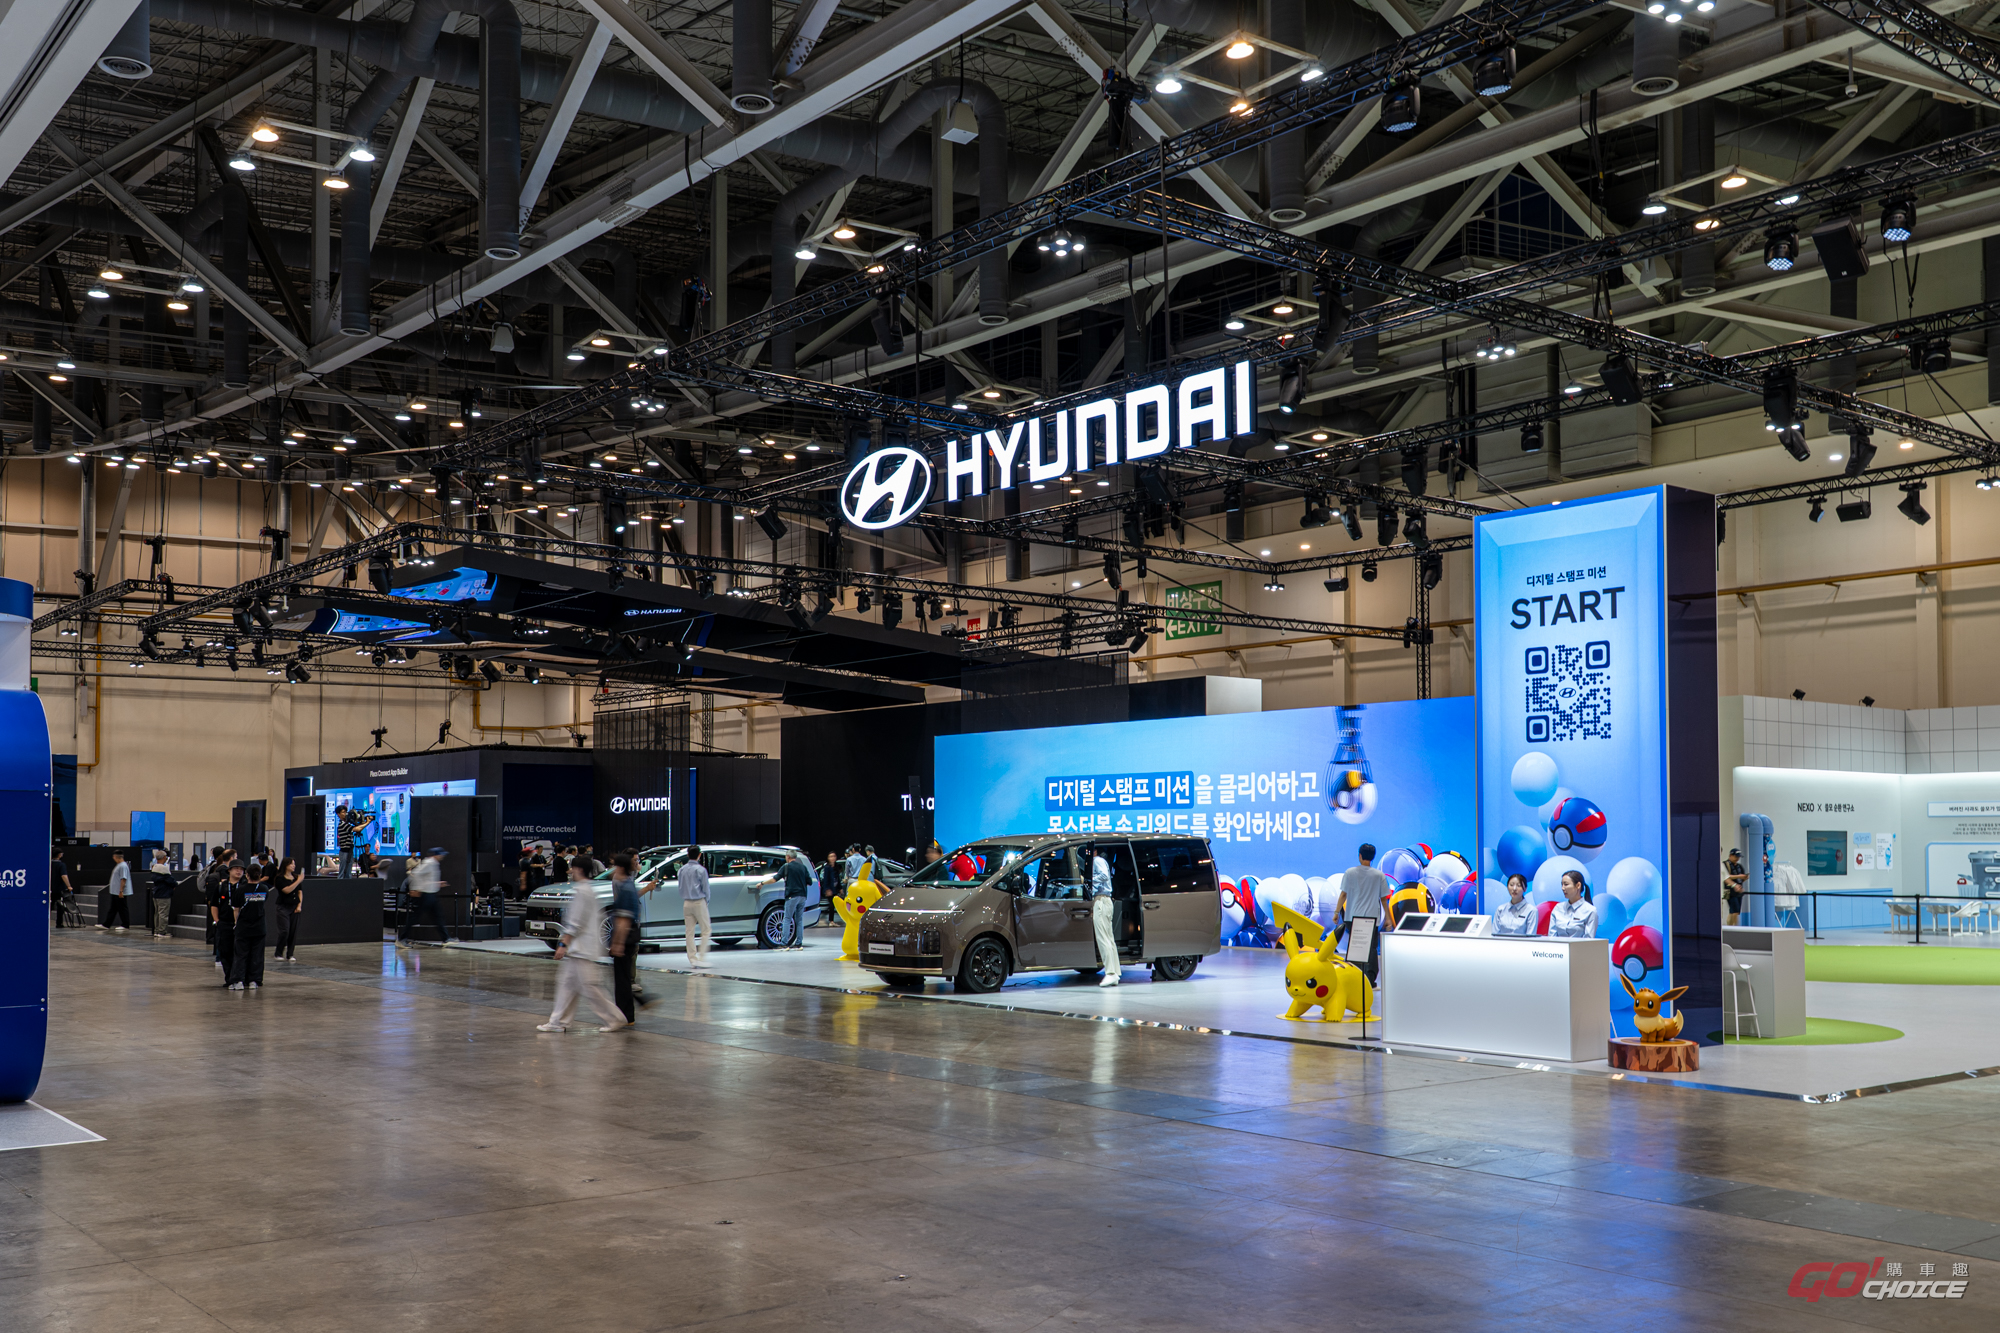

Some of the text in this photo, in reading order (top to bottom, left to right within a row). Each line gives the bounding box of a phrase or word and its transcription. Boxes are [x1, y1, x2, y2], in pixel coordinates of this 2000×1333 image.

[947, 360, 1252, 501] HYUNDAI
[1526, 565, 1607, 587] 디지털 스탬프 미션
[1510, 586, 1625, 630] START
[1049, 778, 1095, 807] 디지털
[1099, 777, 1151, 806] 스탬프
[1217, 770, 1320, 804] 클리어하고
[628, 797, 670, 812] HYUNDAI
[1797, 802, 1815, 812] NEXO
[503, 825, 577, 833] AVANTE Connected
[1213, 811, 1320, 842] 확인하세요!
[1532, 951, 1564, 959] Welcome
